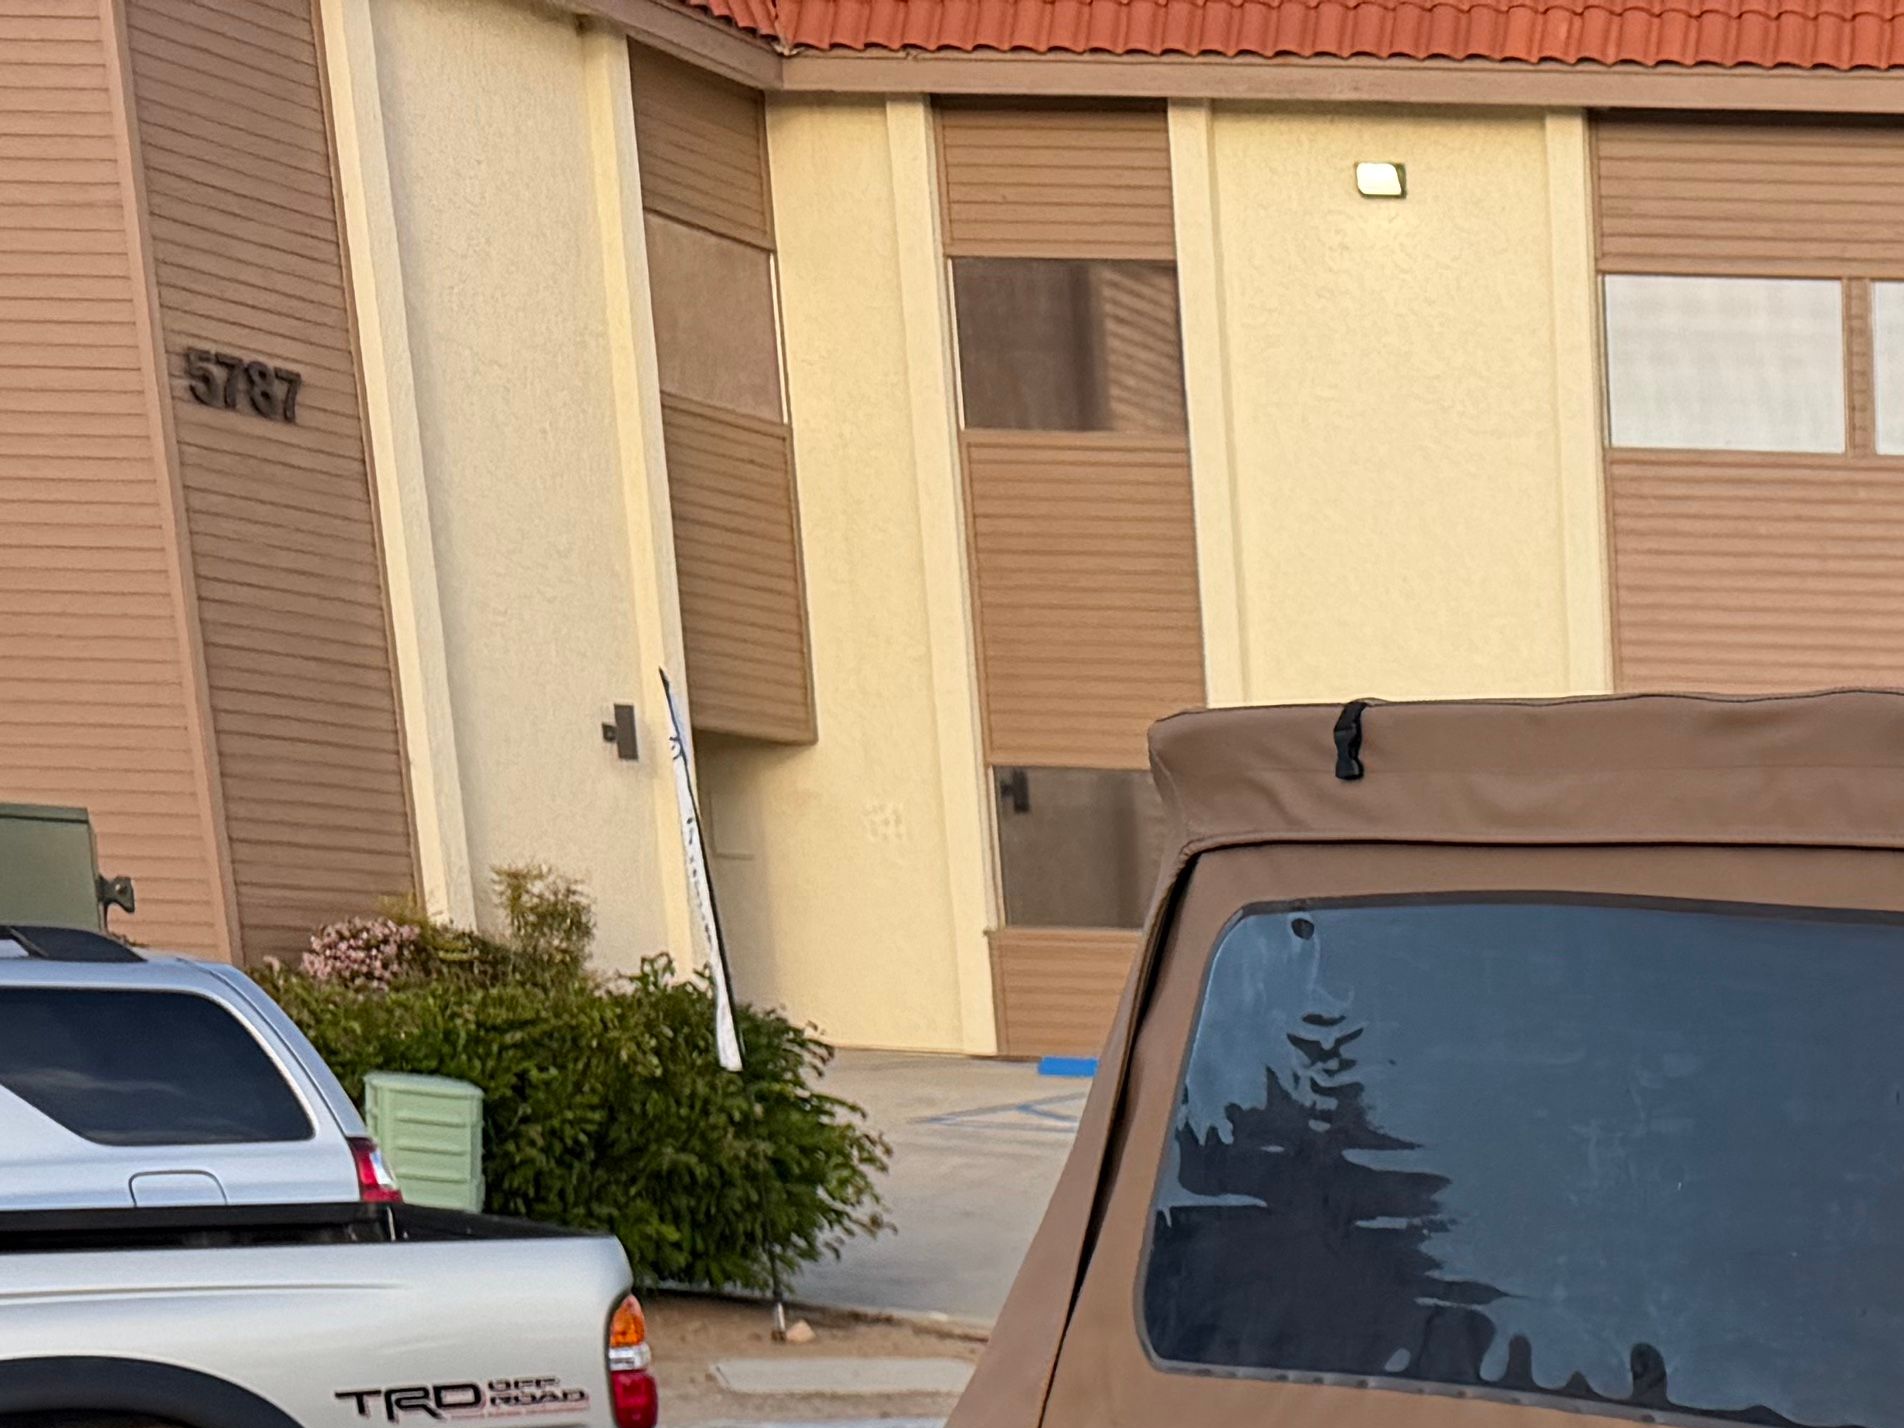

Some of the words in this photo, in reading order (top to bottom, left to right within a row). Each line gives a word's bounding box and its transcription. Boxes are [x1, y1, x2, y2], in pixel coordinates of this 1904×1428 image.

[186, 347, 302, 424] 5787
[488, 1376, 558, 1391] OFF
[489, 1389, 587, 1407] ROAD
[334, 1382, 483, 1423] TRD
